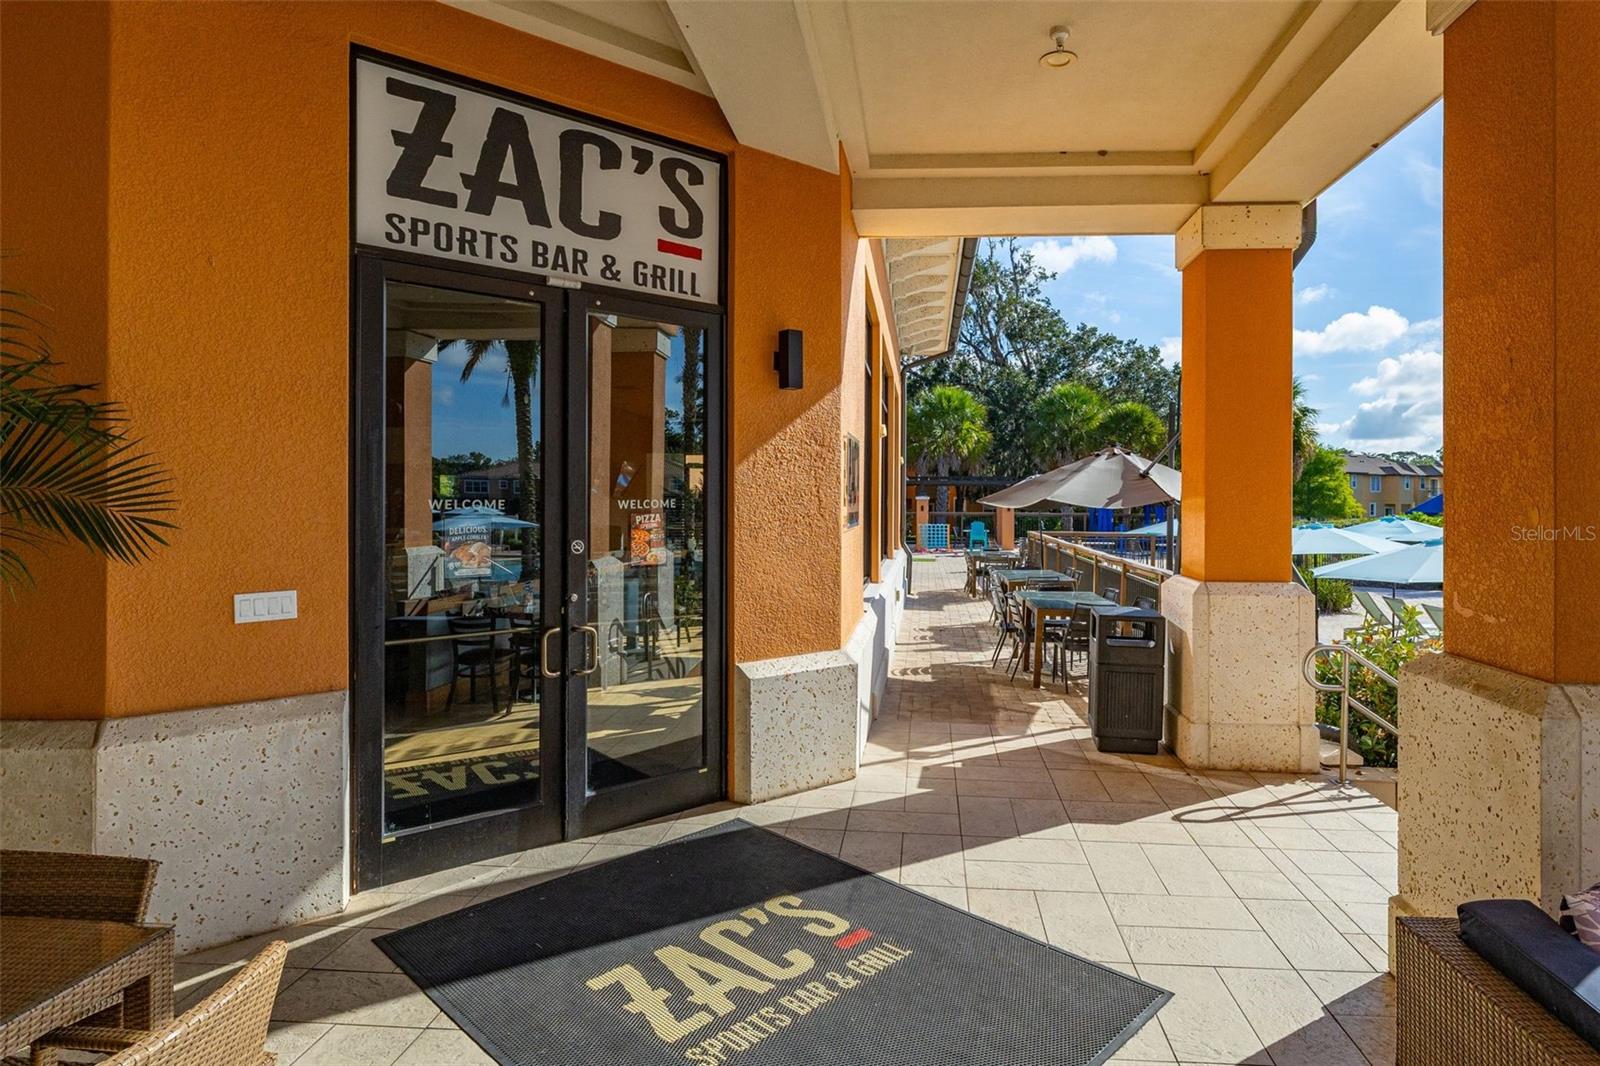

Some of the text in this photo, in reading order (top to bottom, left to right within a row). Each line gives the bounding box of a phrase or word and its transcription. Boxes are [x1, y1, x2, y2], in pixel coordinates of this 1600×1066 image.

[386, 76, 704, 240] ZAC'S
[385, 212, 702, 297] SPORTS BAR & GRILL
[428, 498, 506, 511] WELCOME
[617, 498, 677, 510] WELCOME
[635, 513, 662, 525] PIZZA
[585, 894, 850, 1044] ZAC'S
[685, 942, 913, 1066] SPORTS BAR & GRILL
